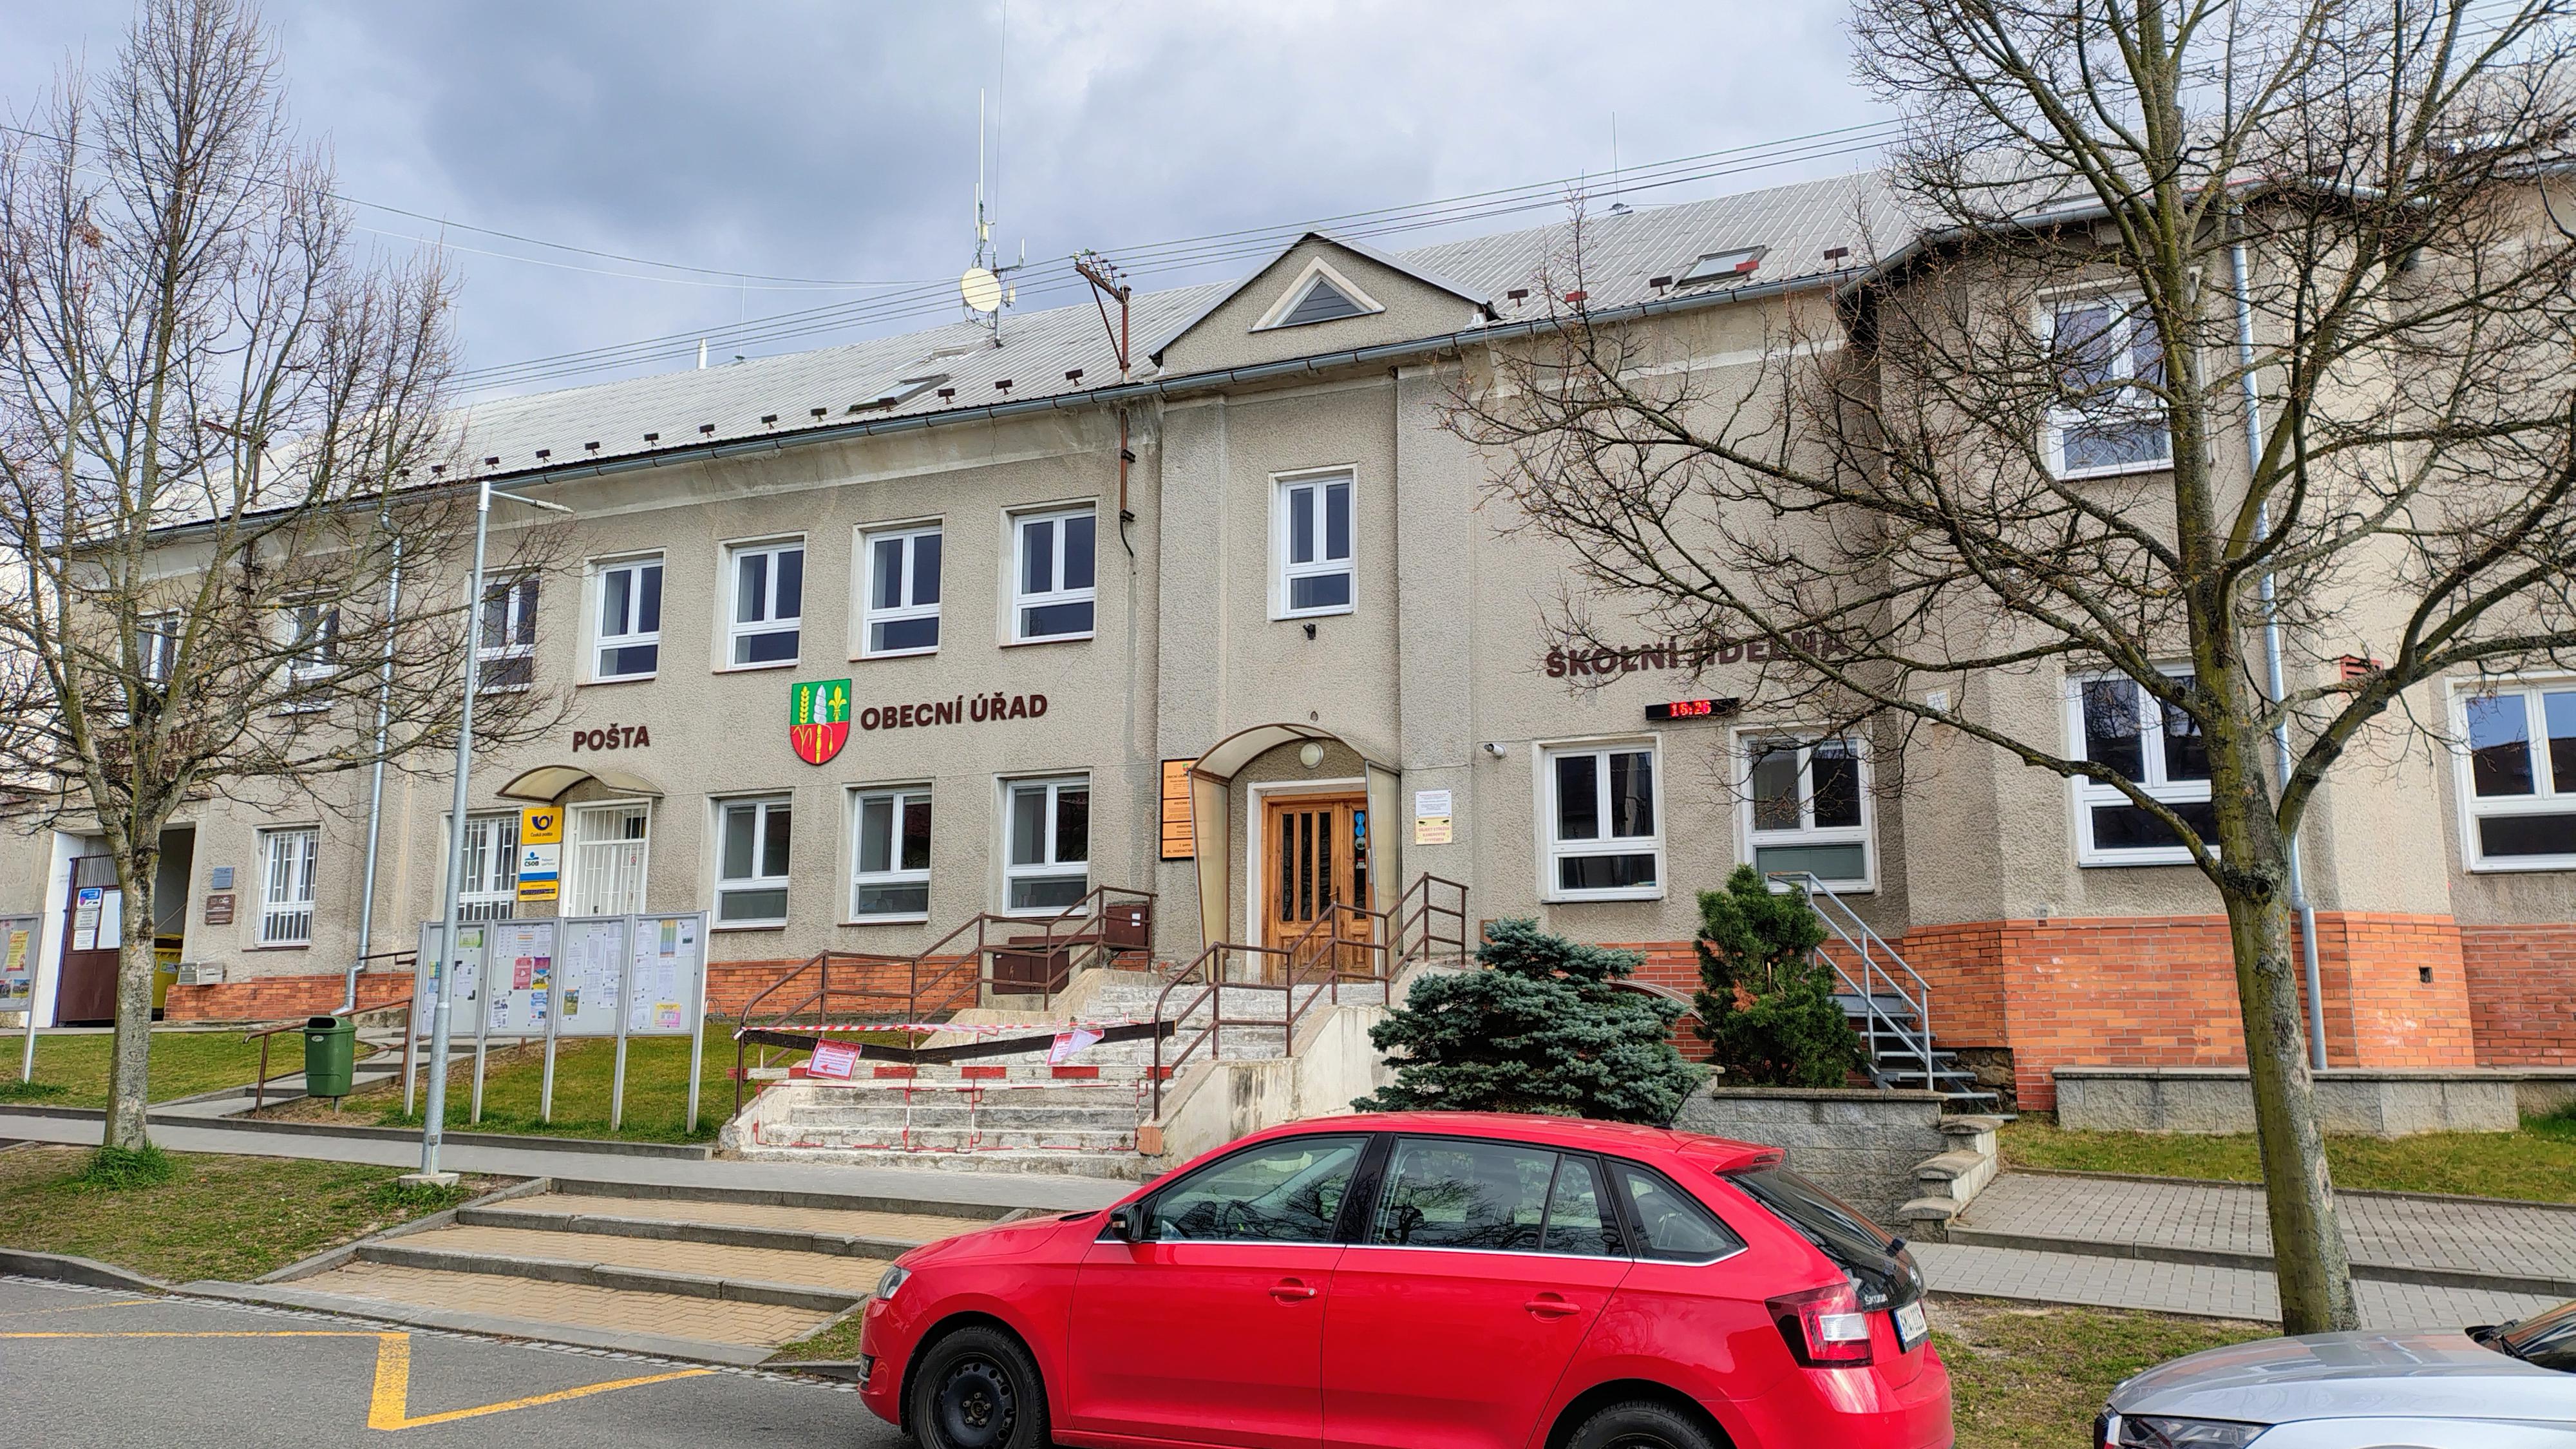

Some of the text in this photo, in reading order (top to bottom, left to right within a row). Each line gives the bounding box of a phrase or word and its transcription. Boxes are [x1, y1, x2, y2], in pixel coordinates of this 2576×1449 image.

[1546, 634, 1678, 678] ŠKOLNÍ
[860, 692, 1048, 731] OBECNÍ ÚŘAD
[572, 723, 650, 753] POŠTA
